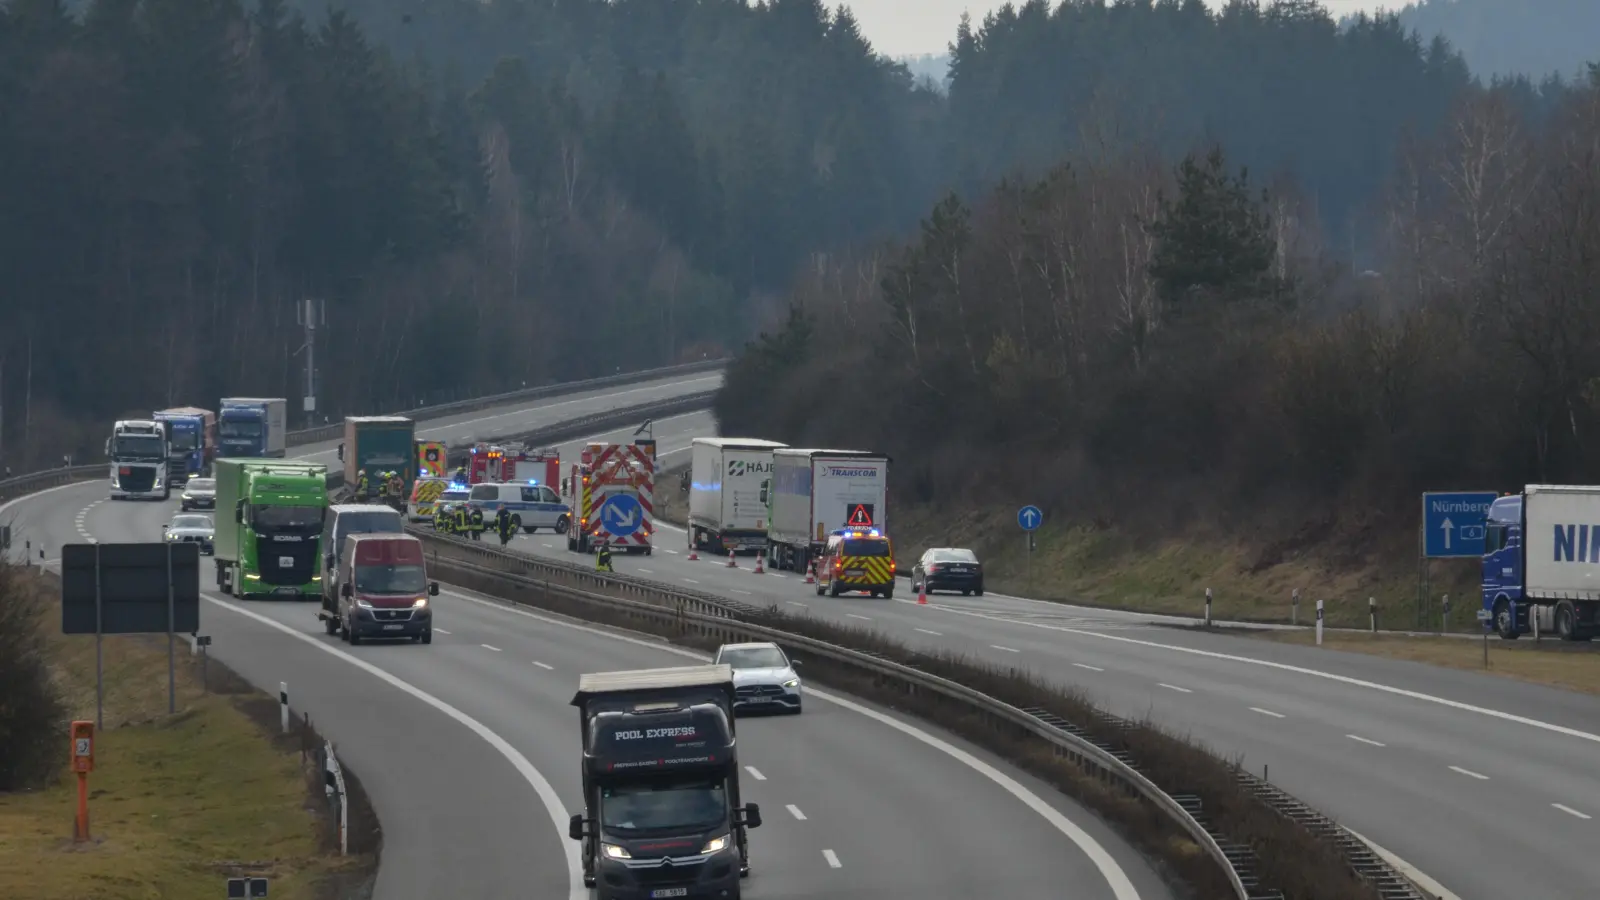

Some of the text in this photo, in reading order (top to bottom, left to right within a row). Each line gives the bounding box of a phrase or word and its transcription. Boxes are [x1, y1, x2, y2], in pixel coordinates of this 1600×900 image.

[831, 469, 877, 477] TRANSCOM
[1432, 500, 1490, 514] Nürnberg
[615, 726, 695, 740] POOL EXPRESS
